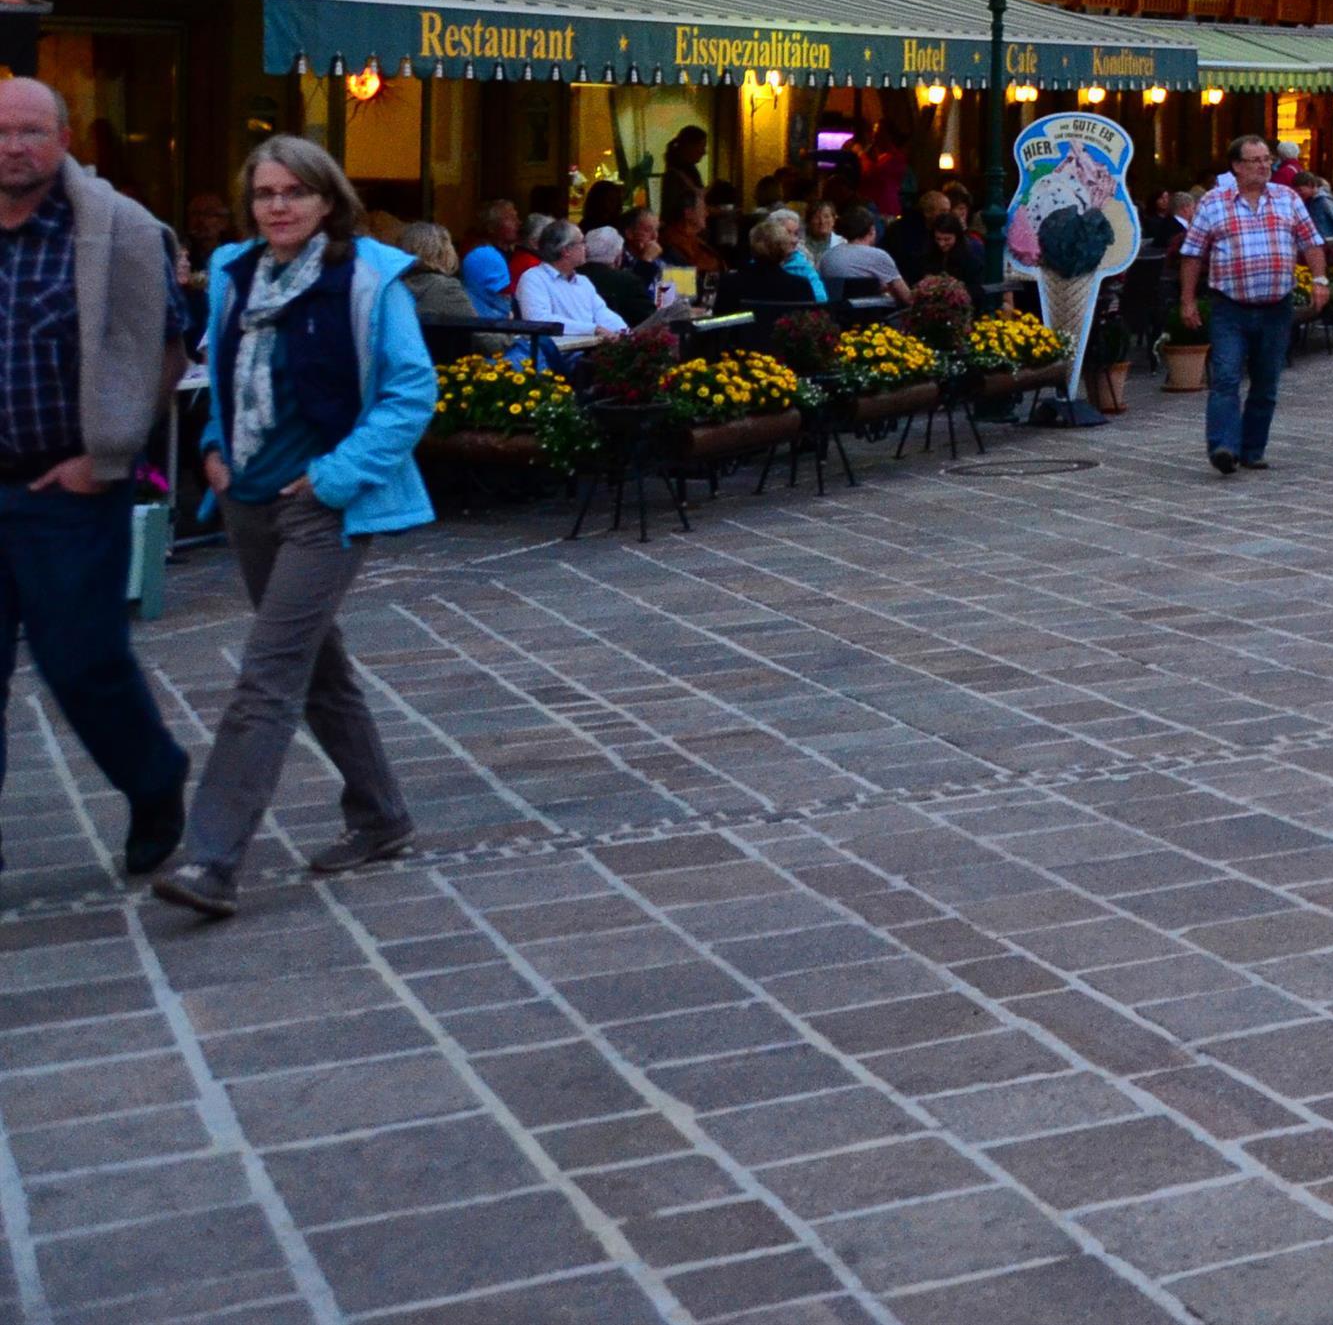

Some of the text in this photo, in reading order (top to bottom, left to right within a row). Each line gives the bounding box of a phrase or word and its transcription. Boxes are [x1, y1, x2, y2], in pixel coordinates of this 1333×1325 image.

[419, 11, 575, 60] Restaurant
[674, 25, 831, 76] Eisspezialitäten
[903, 38, 946, 73] Hotel
[1092, 47, 1155, 76] Konditorei
[1072, 119, 1098, 135] GUTE
[1098, 126, 1116, 143] EIS
[1022, 140, 1053, 162] HIER
